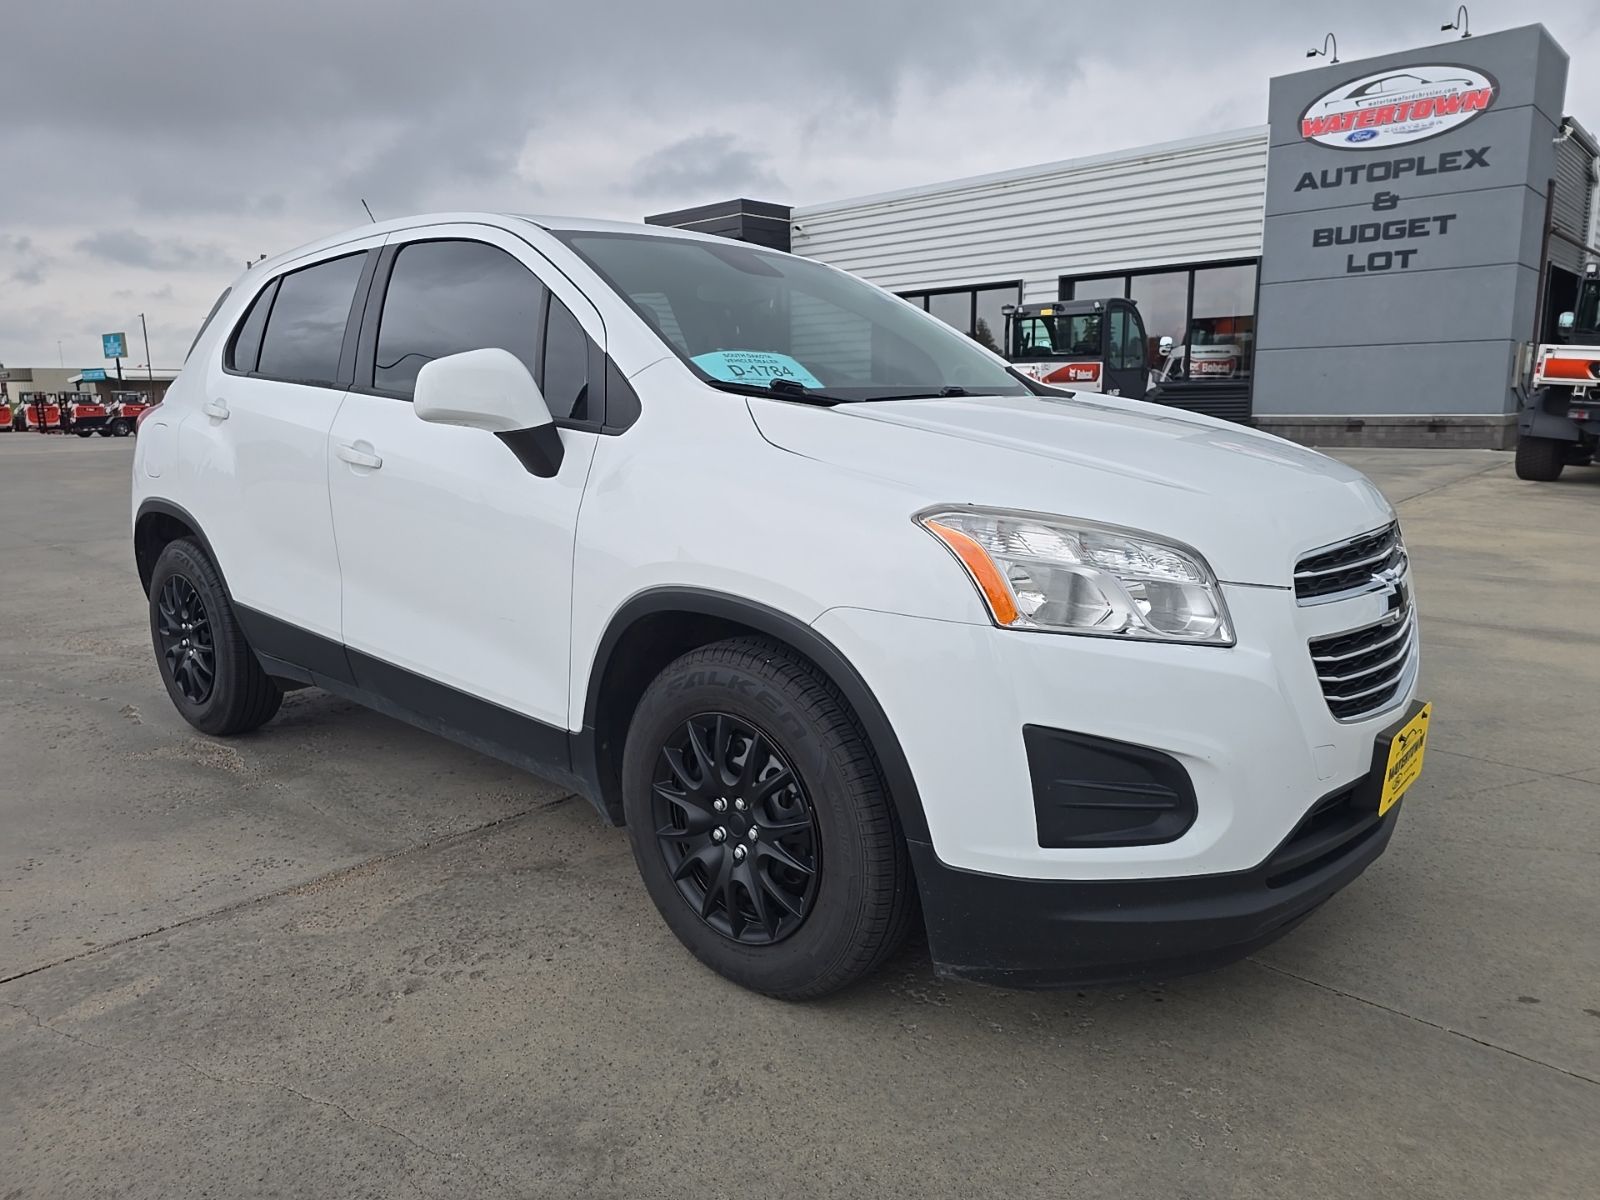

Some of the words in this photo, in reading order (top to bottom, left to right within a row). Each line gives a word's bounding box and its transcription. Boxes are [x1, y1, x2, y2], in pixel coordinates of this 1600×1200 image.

[1301, 87, 1494, 138] WATERTOWN
[1294, 146, 1491, 192] AUTOPLEX
[1372, 191, 1399, 211] &
[1312, 214, 1457, 247] BUDGET
[1346, 249, 1418, 273] LOT
[727, 364, 794, 377] D-1784
[1202, 362, 1231, 372] Bobcat
[664, 671, 808, 740] FALKEN
